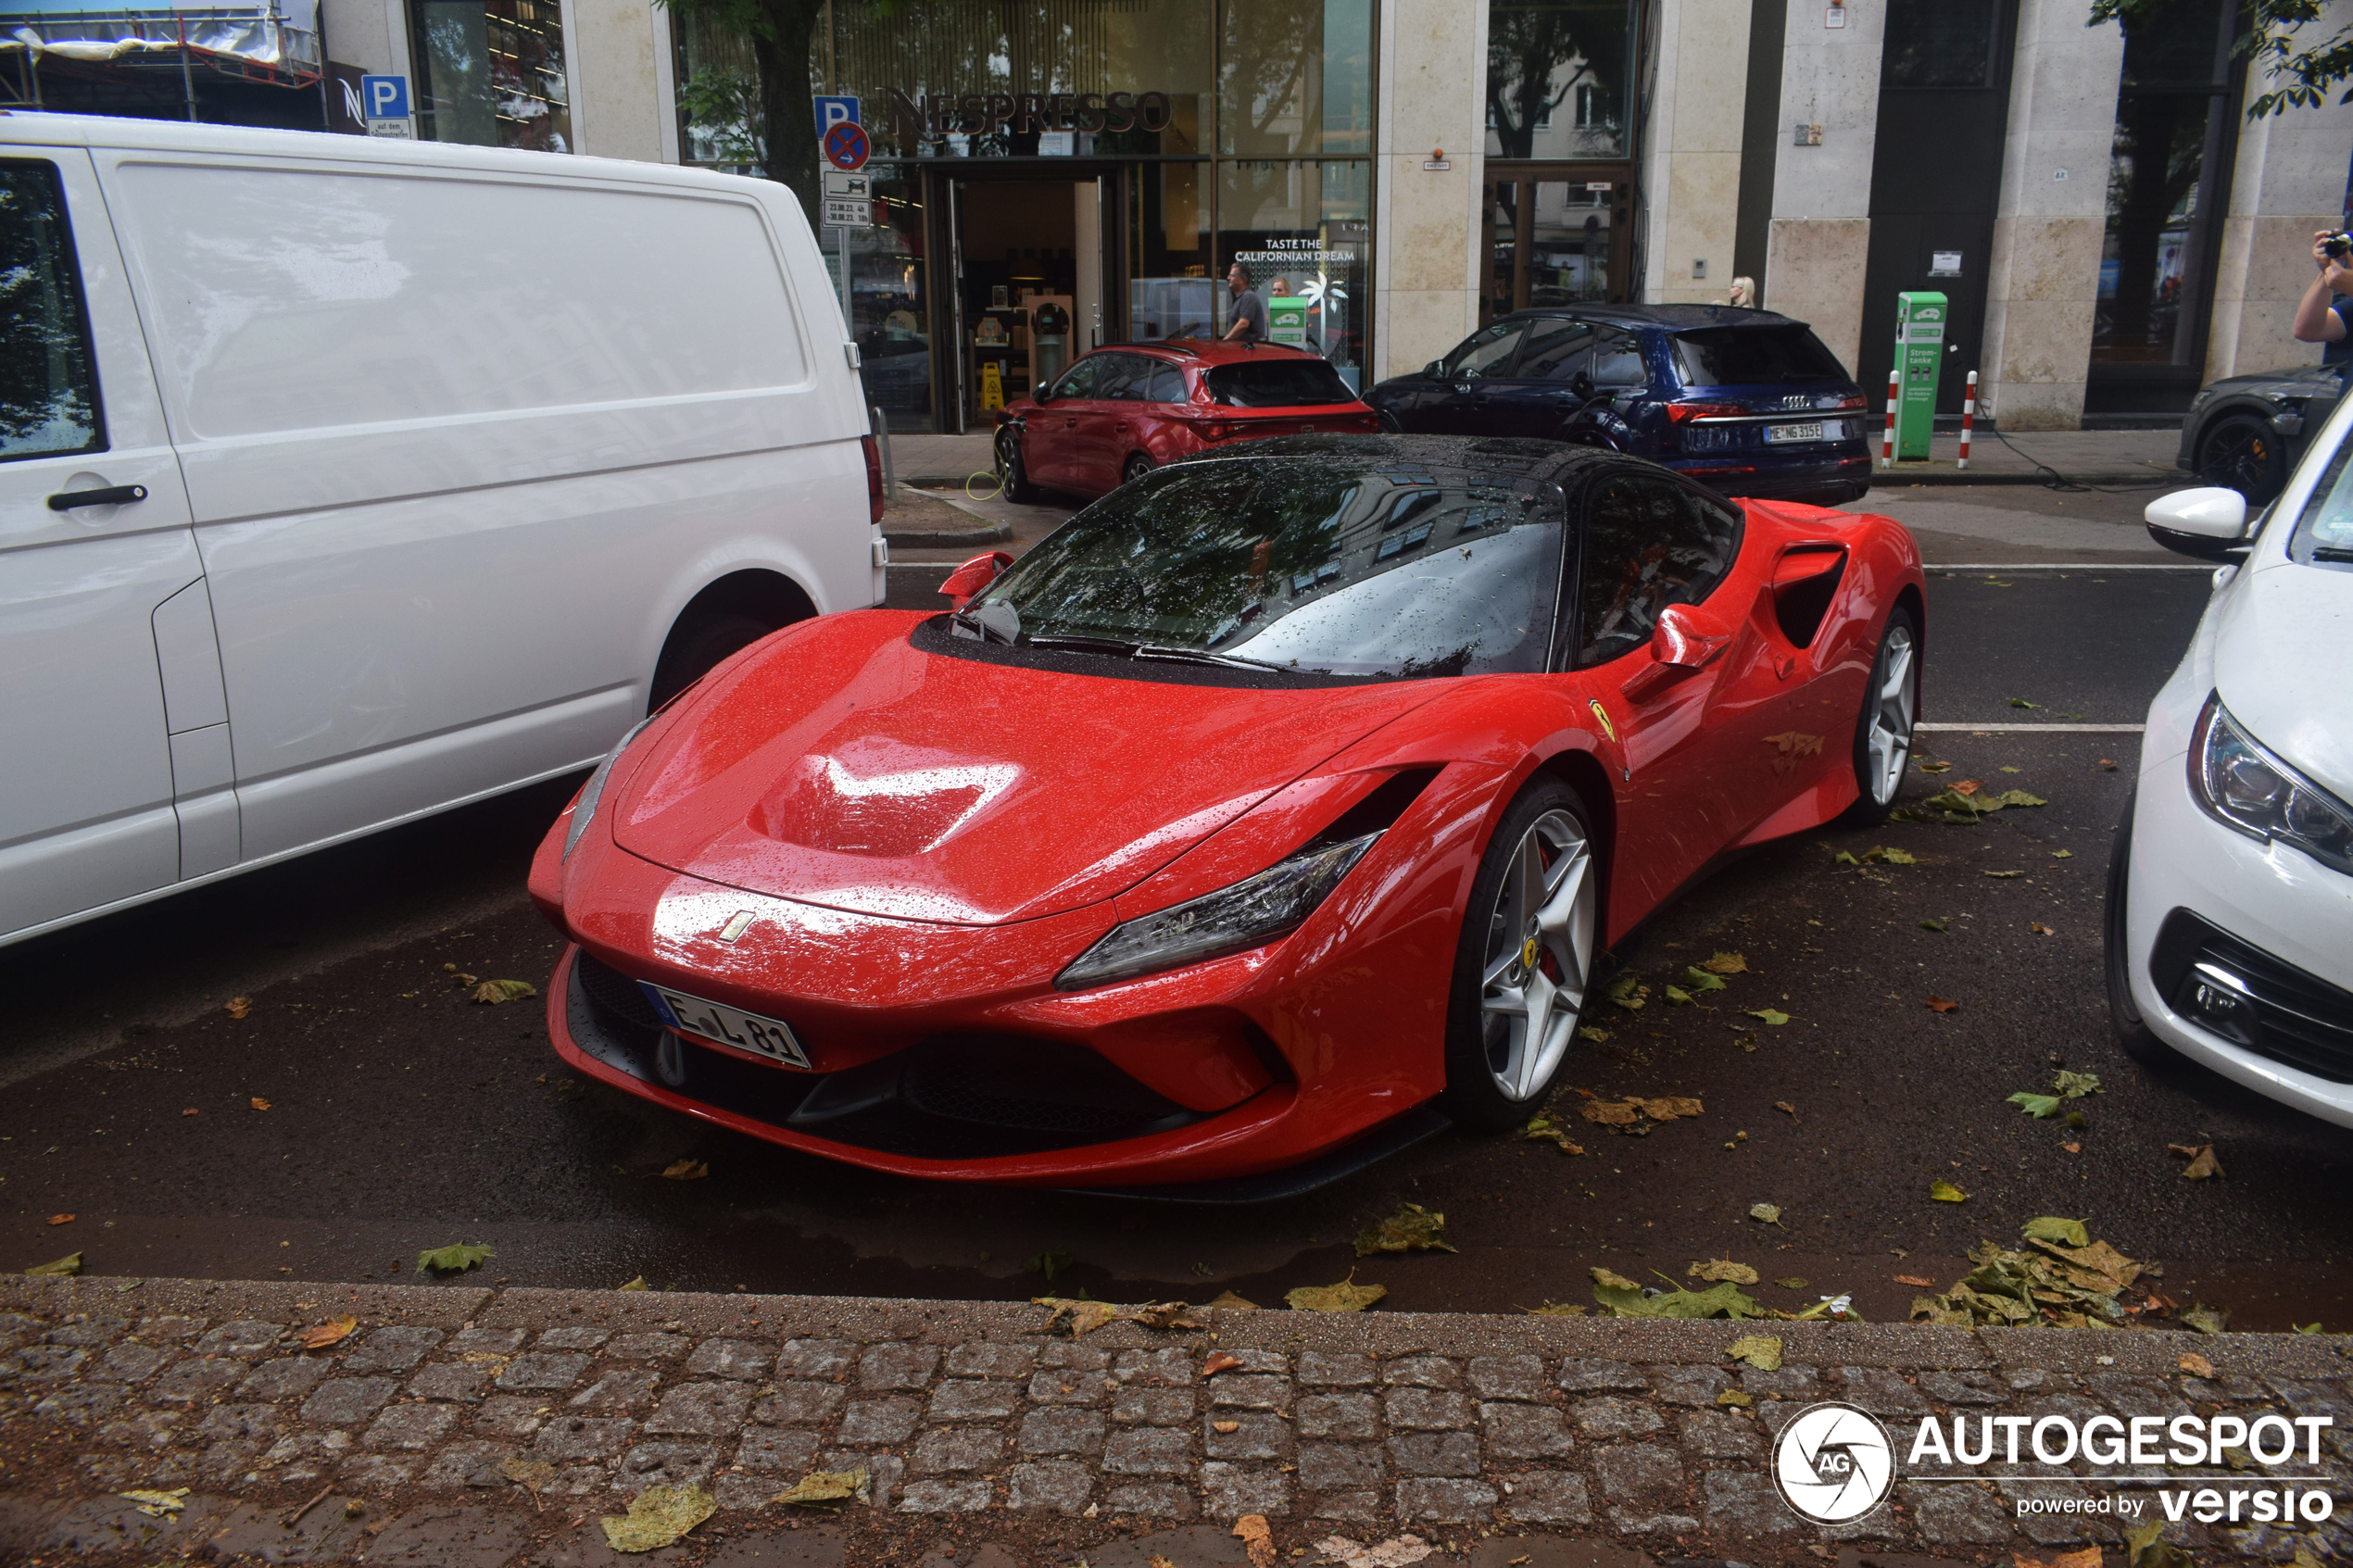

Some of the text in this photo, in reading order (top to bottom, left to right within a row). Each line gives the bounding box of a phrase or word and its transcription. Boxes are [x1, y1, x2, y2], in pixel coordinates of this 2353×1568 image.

[373, 82, 396, 115] P
[825, 102, 849, 130] P
[875, 87, 1172, 144] NESPRESSO
[1235, 251, 1354, 262] CALIFORNIAN DREAM
[1265, 239, 1322, 249] TASTE THE
[1769, 427, 1780, 440] ME
[1786, 425, 1797, 438] NG
[745, 1019, 803, 1061] 81
